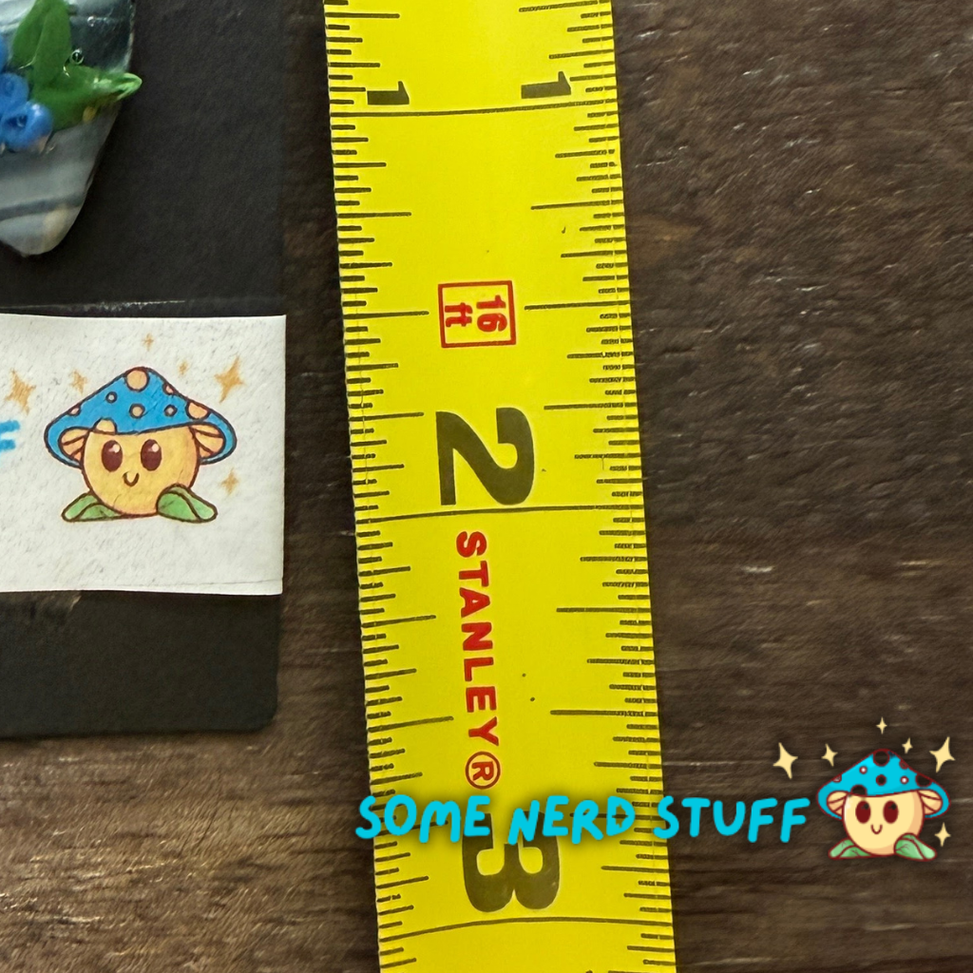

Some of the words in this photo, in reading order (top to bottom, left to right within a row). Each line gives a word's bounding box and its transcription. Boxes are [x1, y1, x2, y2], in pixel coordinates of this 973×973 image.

[367, 80, 410, 106] 1
[521, 71, 572, 99] 1
[435, 406, 535, 506] 2
[461, 810, 561, 913] 3
